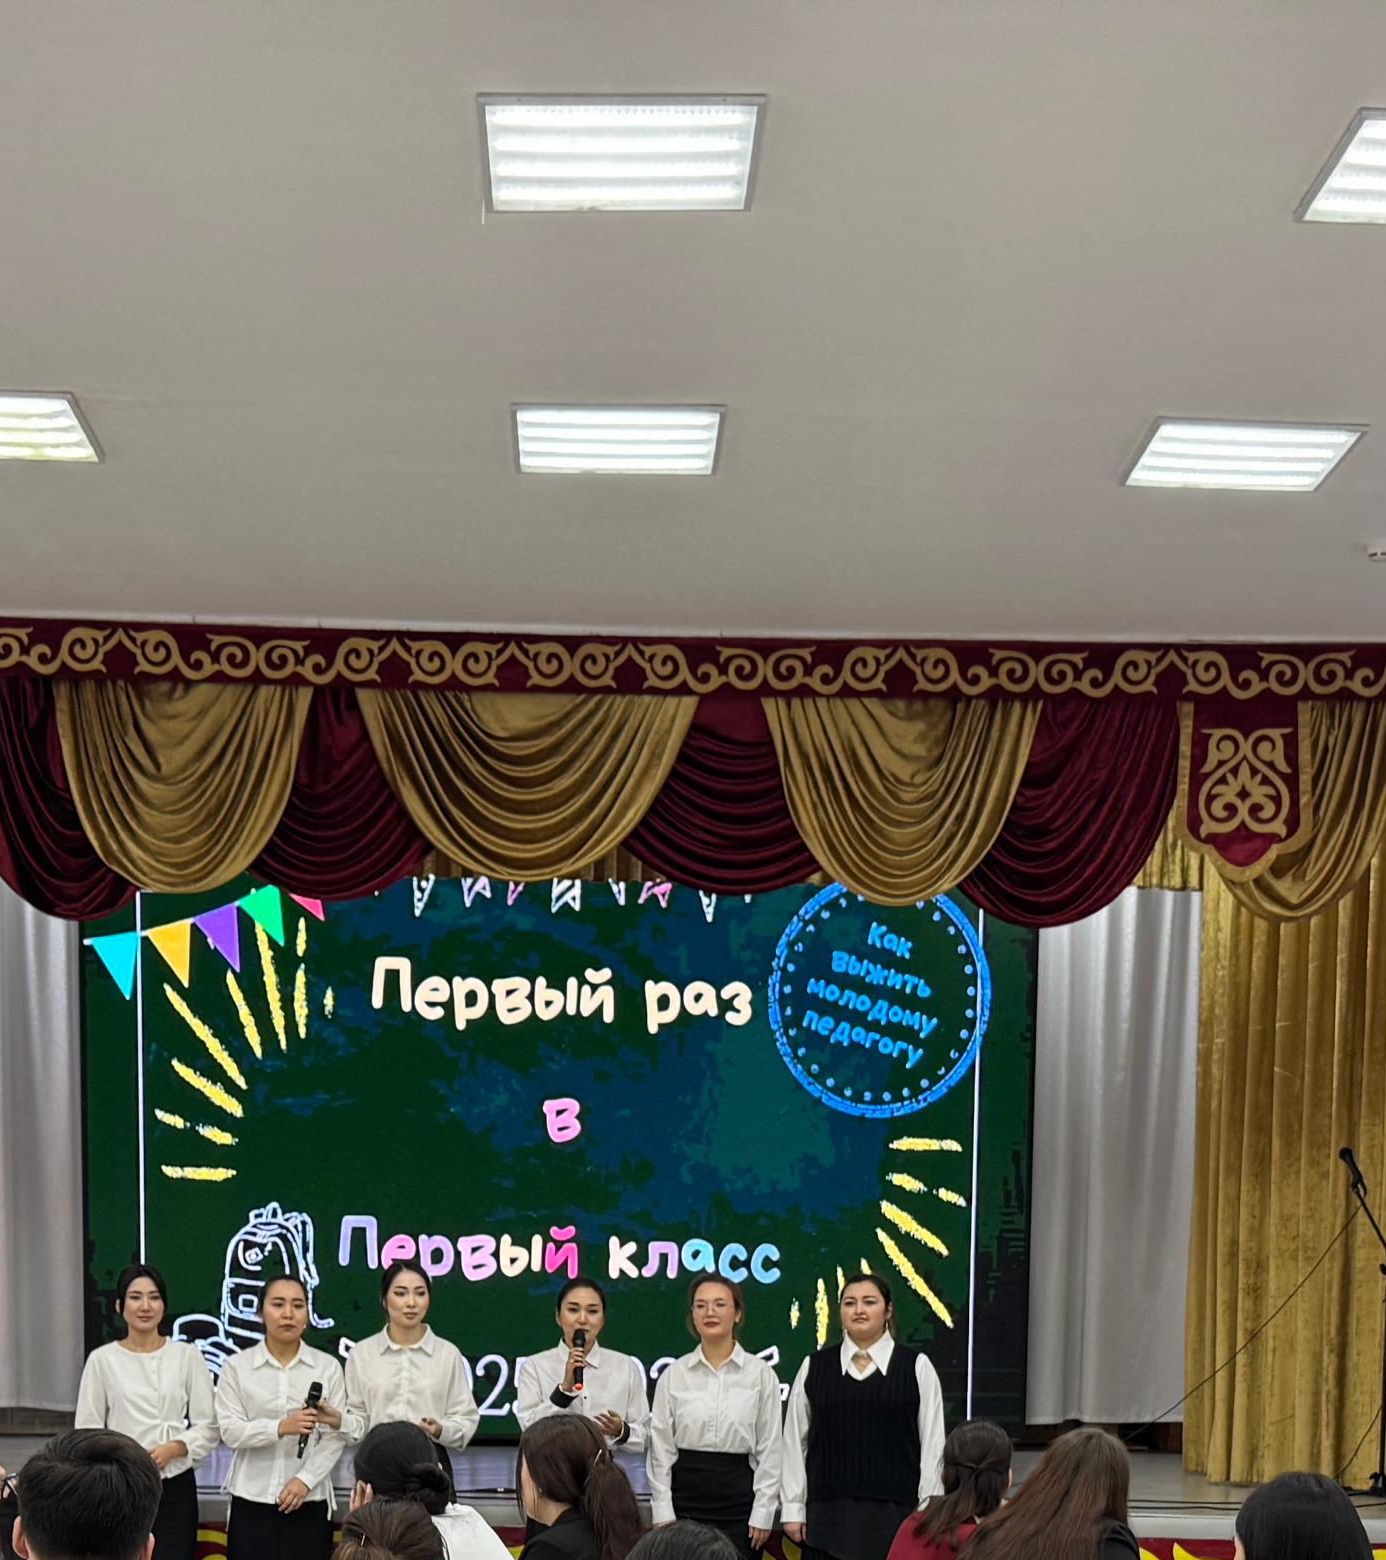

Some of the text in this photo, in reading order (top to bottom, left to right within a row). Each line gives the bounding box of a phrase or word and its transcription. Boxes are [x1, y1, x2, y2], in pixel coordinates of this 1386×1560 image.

[867, 921, 913, 960] Как
[371, 955, 753, 1035] Первый раз
[831, 950, 932, 998] выжить
[806, 977, 938, 1039] молодому
[802, 1009, 924, 1070] педагогу
[338, 1214, 781, 1284] Первый класс
